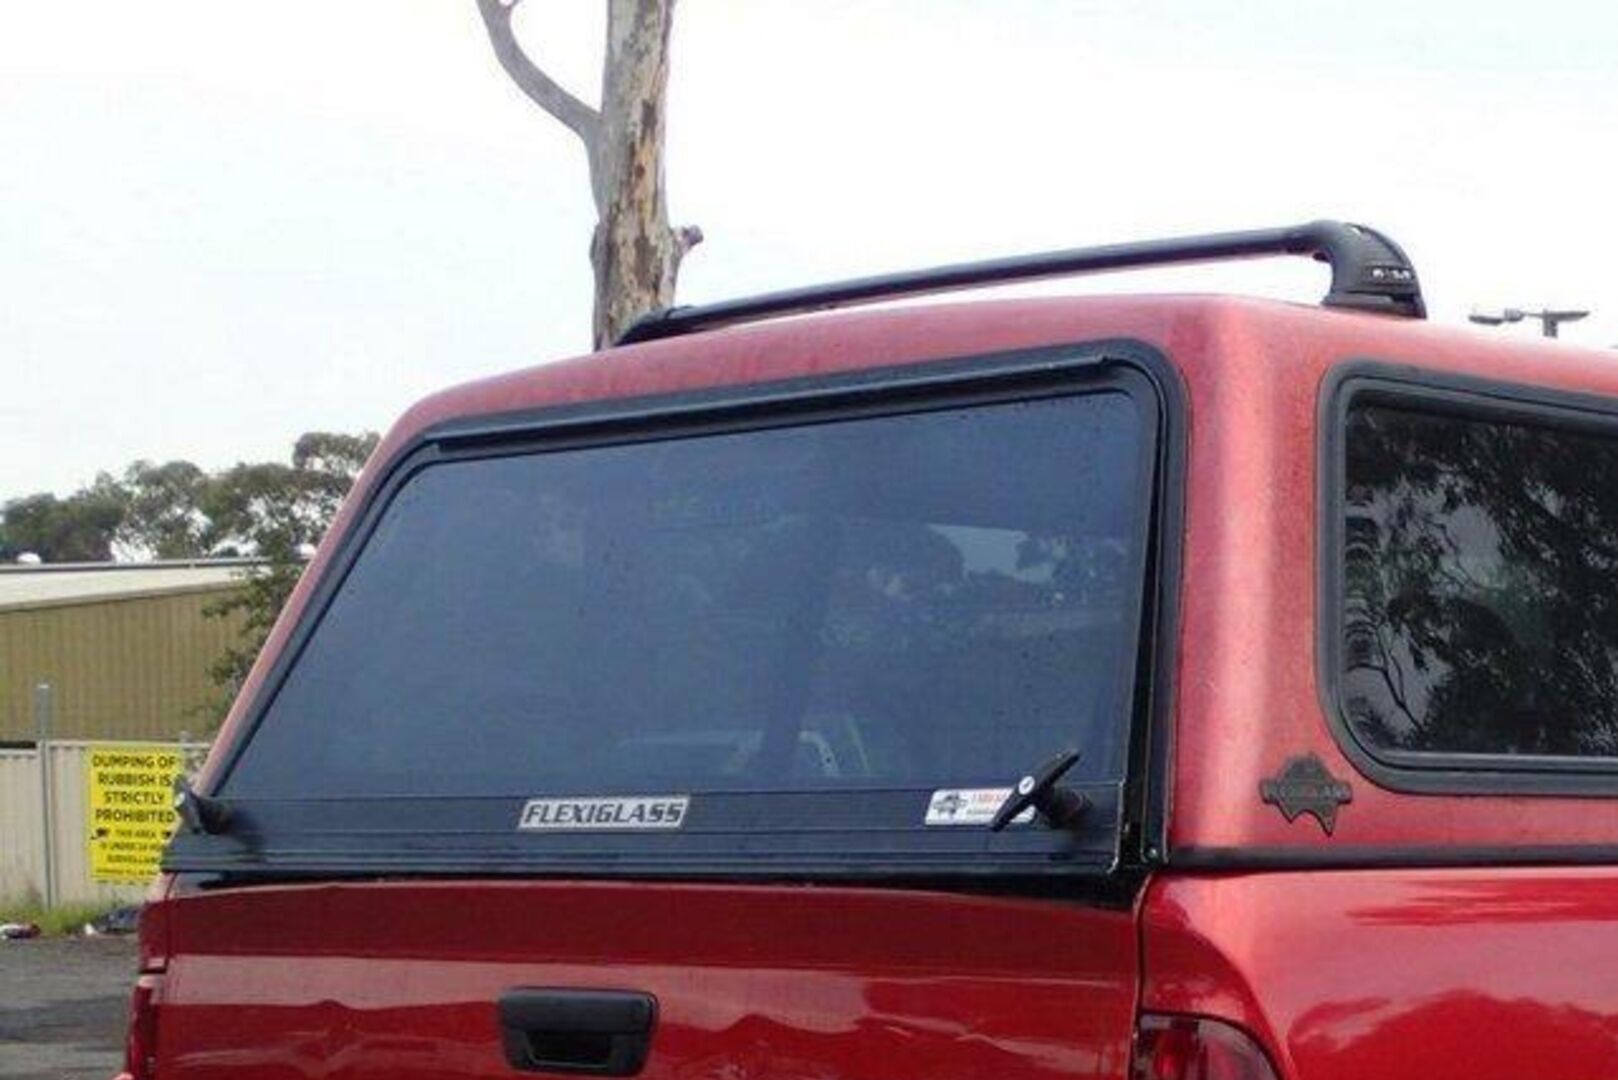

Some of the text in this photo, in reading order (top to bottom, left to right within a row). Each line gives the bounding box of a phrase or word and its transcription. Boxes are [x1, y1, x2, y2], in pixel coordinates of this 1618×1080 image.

[93, 755, 176, 768] DUMPING OF
[98, 772, 172, 787] RUBBISH IS
[104, 791, 165, 804] STRICTLY
[96, 809, 176, 823] PROHIBITED
[524, 803, 684, 823] FLEXIGLASS
